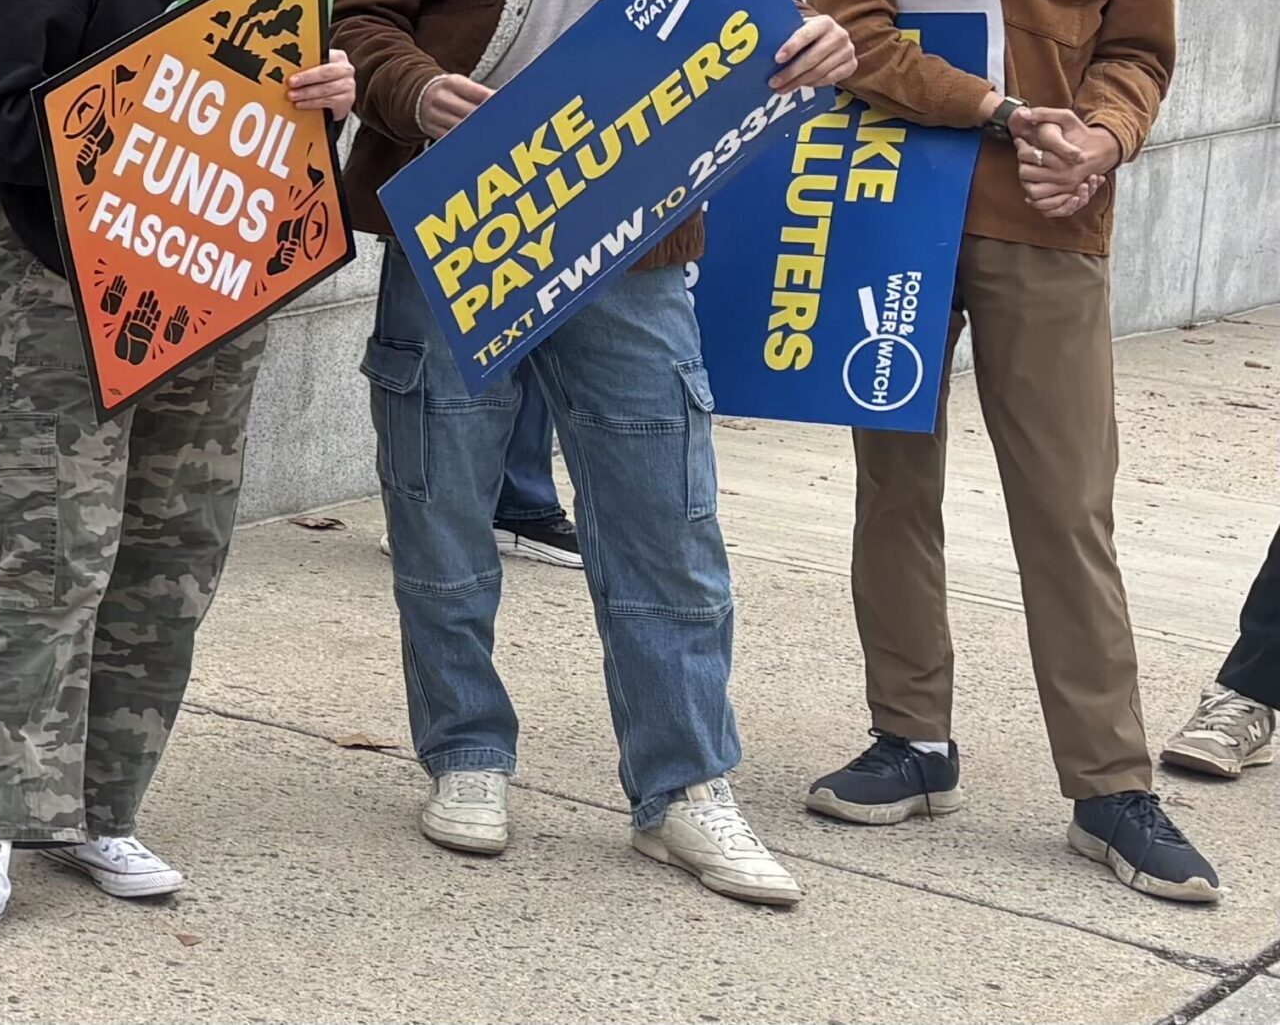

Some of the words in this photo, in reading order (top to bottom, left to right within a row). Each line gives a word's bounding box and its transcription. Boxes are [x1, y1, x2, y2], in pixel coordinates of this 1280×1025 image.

[141, 53, 226, 136] BIG
[229, 101, 297, 180] OIL
[433, 10, 760, 299] POLLUTERS
[112, 122, 275, 243] FUNDS
[414, 95, 595, 261] MAKE
[88, 191, 252, 302] FASCISM
[450, 222, 557, 335] PAY
[473, 307, 535, 366] TEXT
[536, 206, 644, 315] FWW
[651, 185, 687, 219] TO
[881, 273, 903, 333] WATER
[898, 271, 922, 336] FOOD&
[871, 340, 895, 404] WATCH
